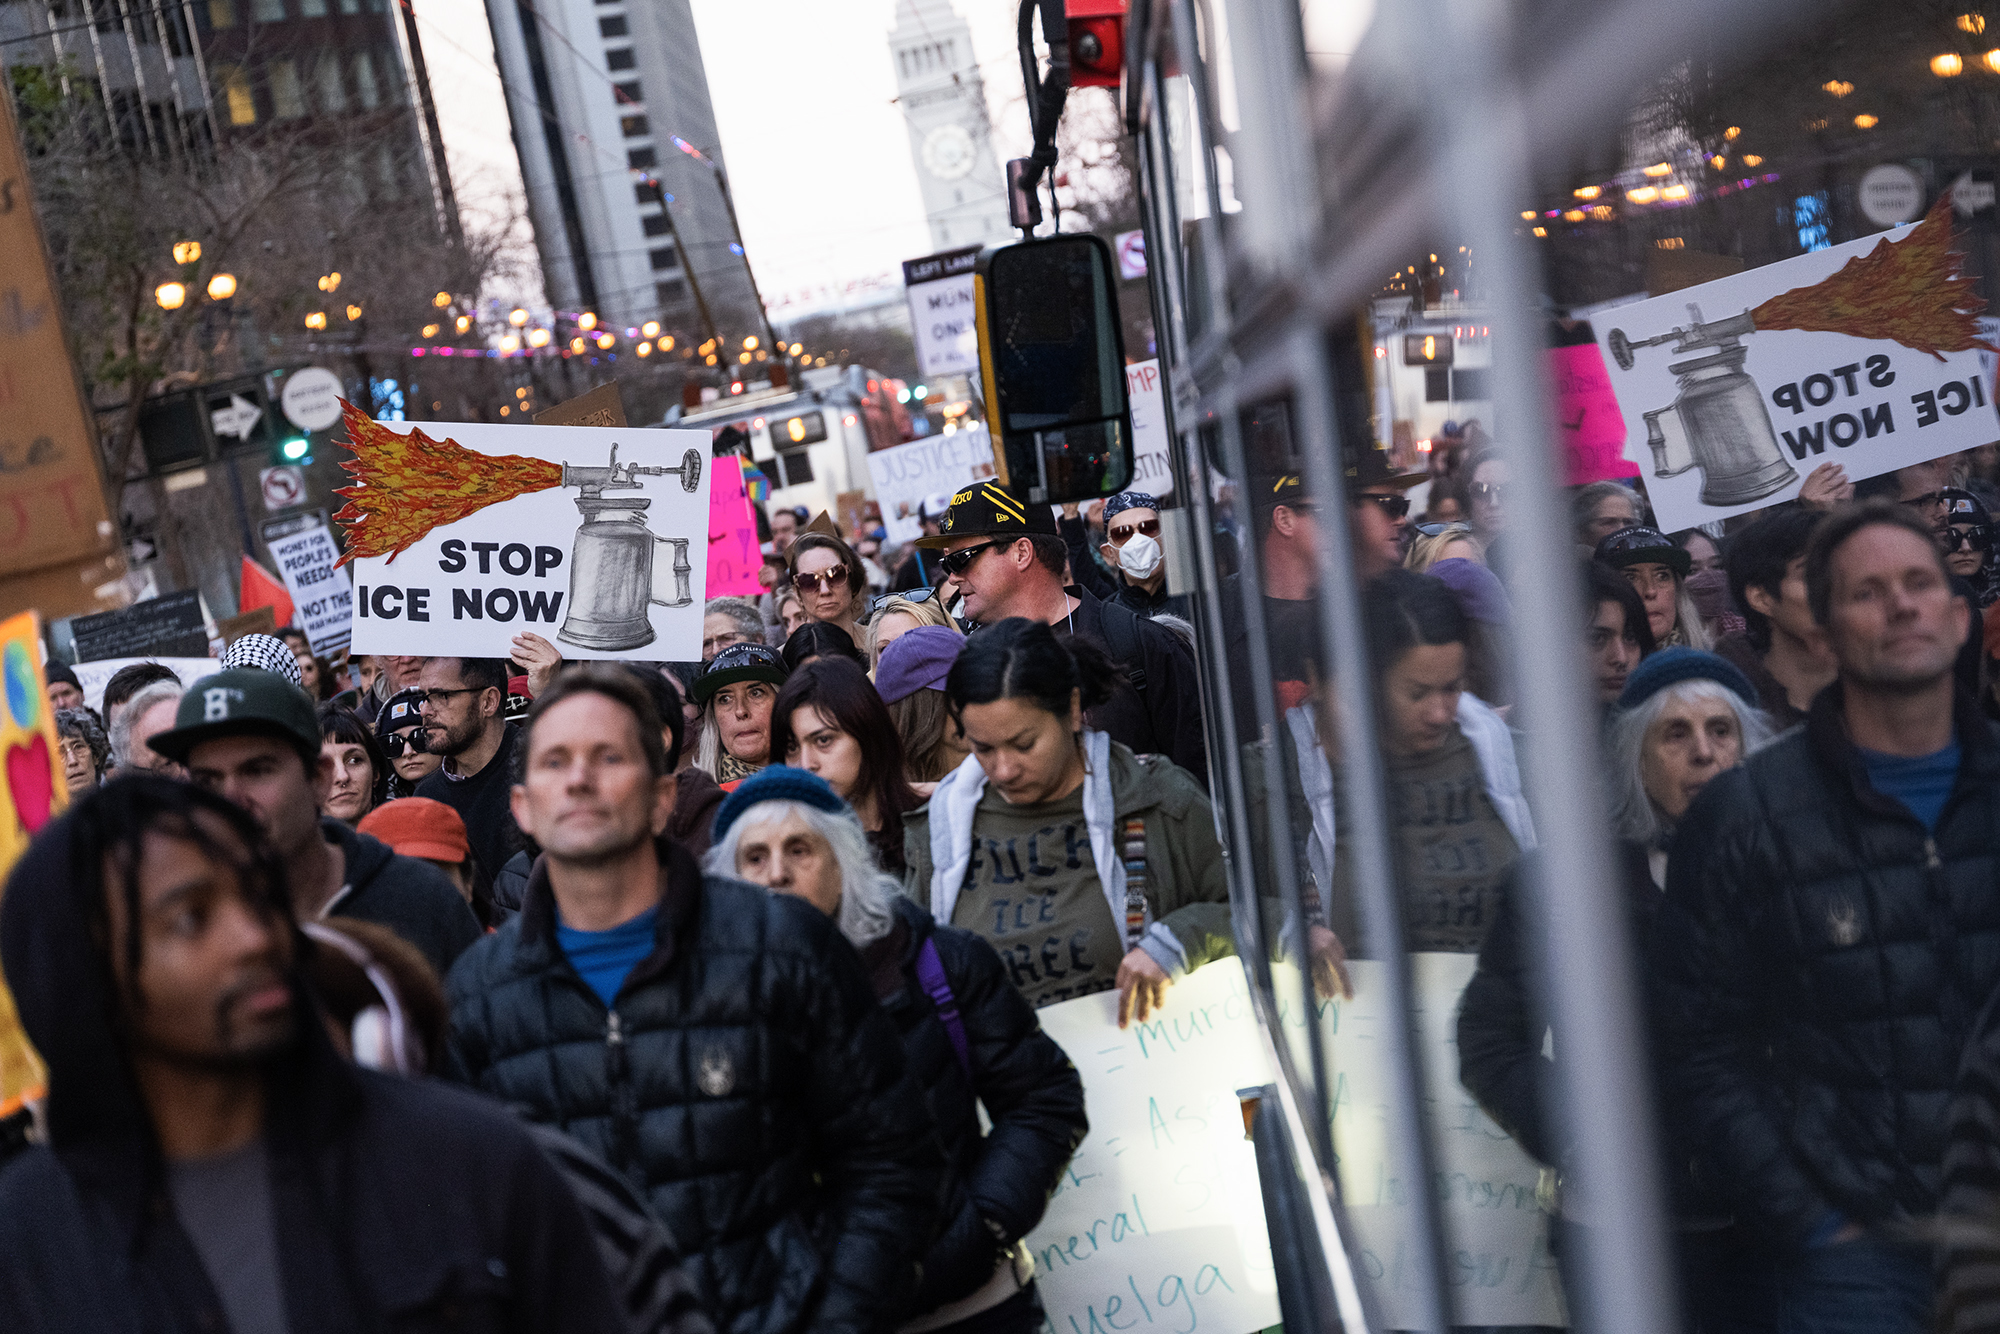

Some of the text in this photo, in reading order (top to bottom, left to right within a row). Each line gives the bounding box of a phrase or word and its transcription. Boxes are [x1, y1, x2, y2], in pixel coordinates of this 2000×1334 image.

[879, 436, 966, 487] JUSTICE
[278, 534, 326, 556] MONEY FOR
[284, 548, 332, 571] PEOPLE'S
[438, 539, 563, 578] STOP
[295, 565, 334, 588] NEEDS
[302, 591, 352, 619] NOT THE
[359, 585, 564, 623] ICE NOW
[1003, 928, 1094, 986] REE
[1045, 1264, 1234, 1334] uelga
